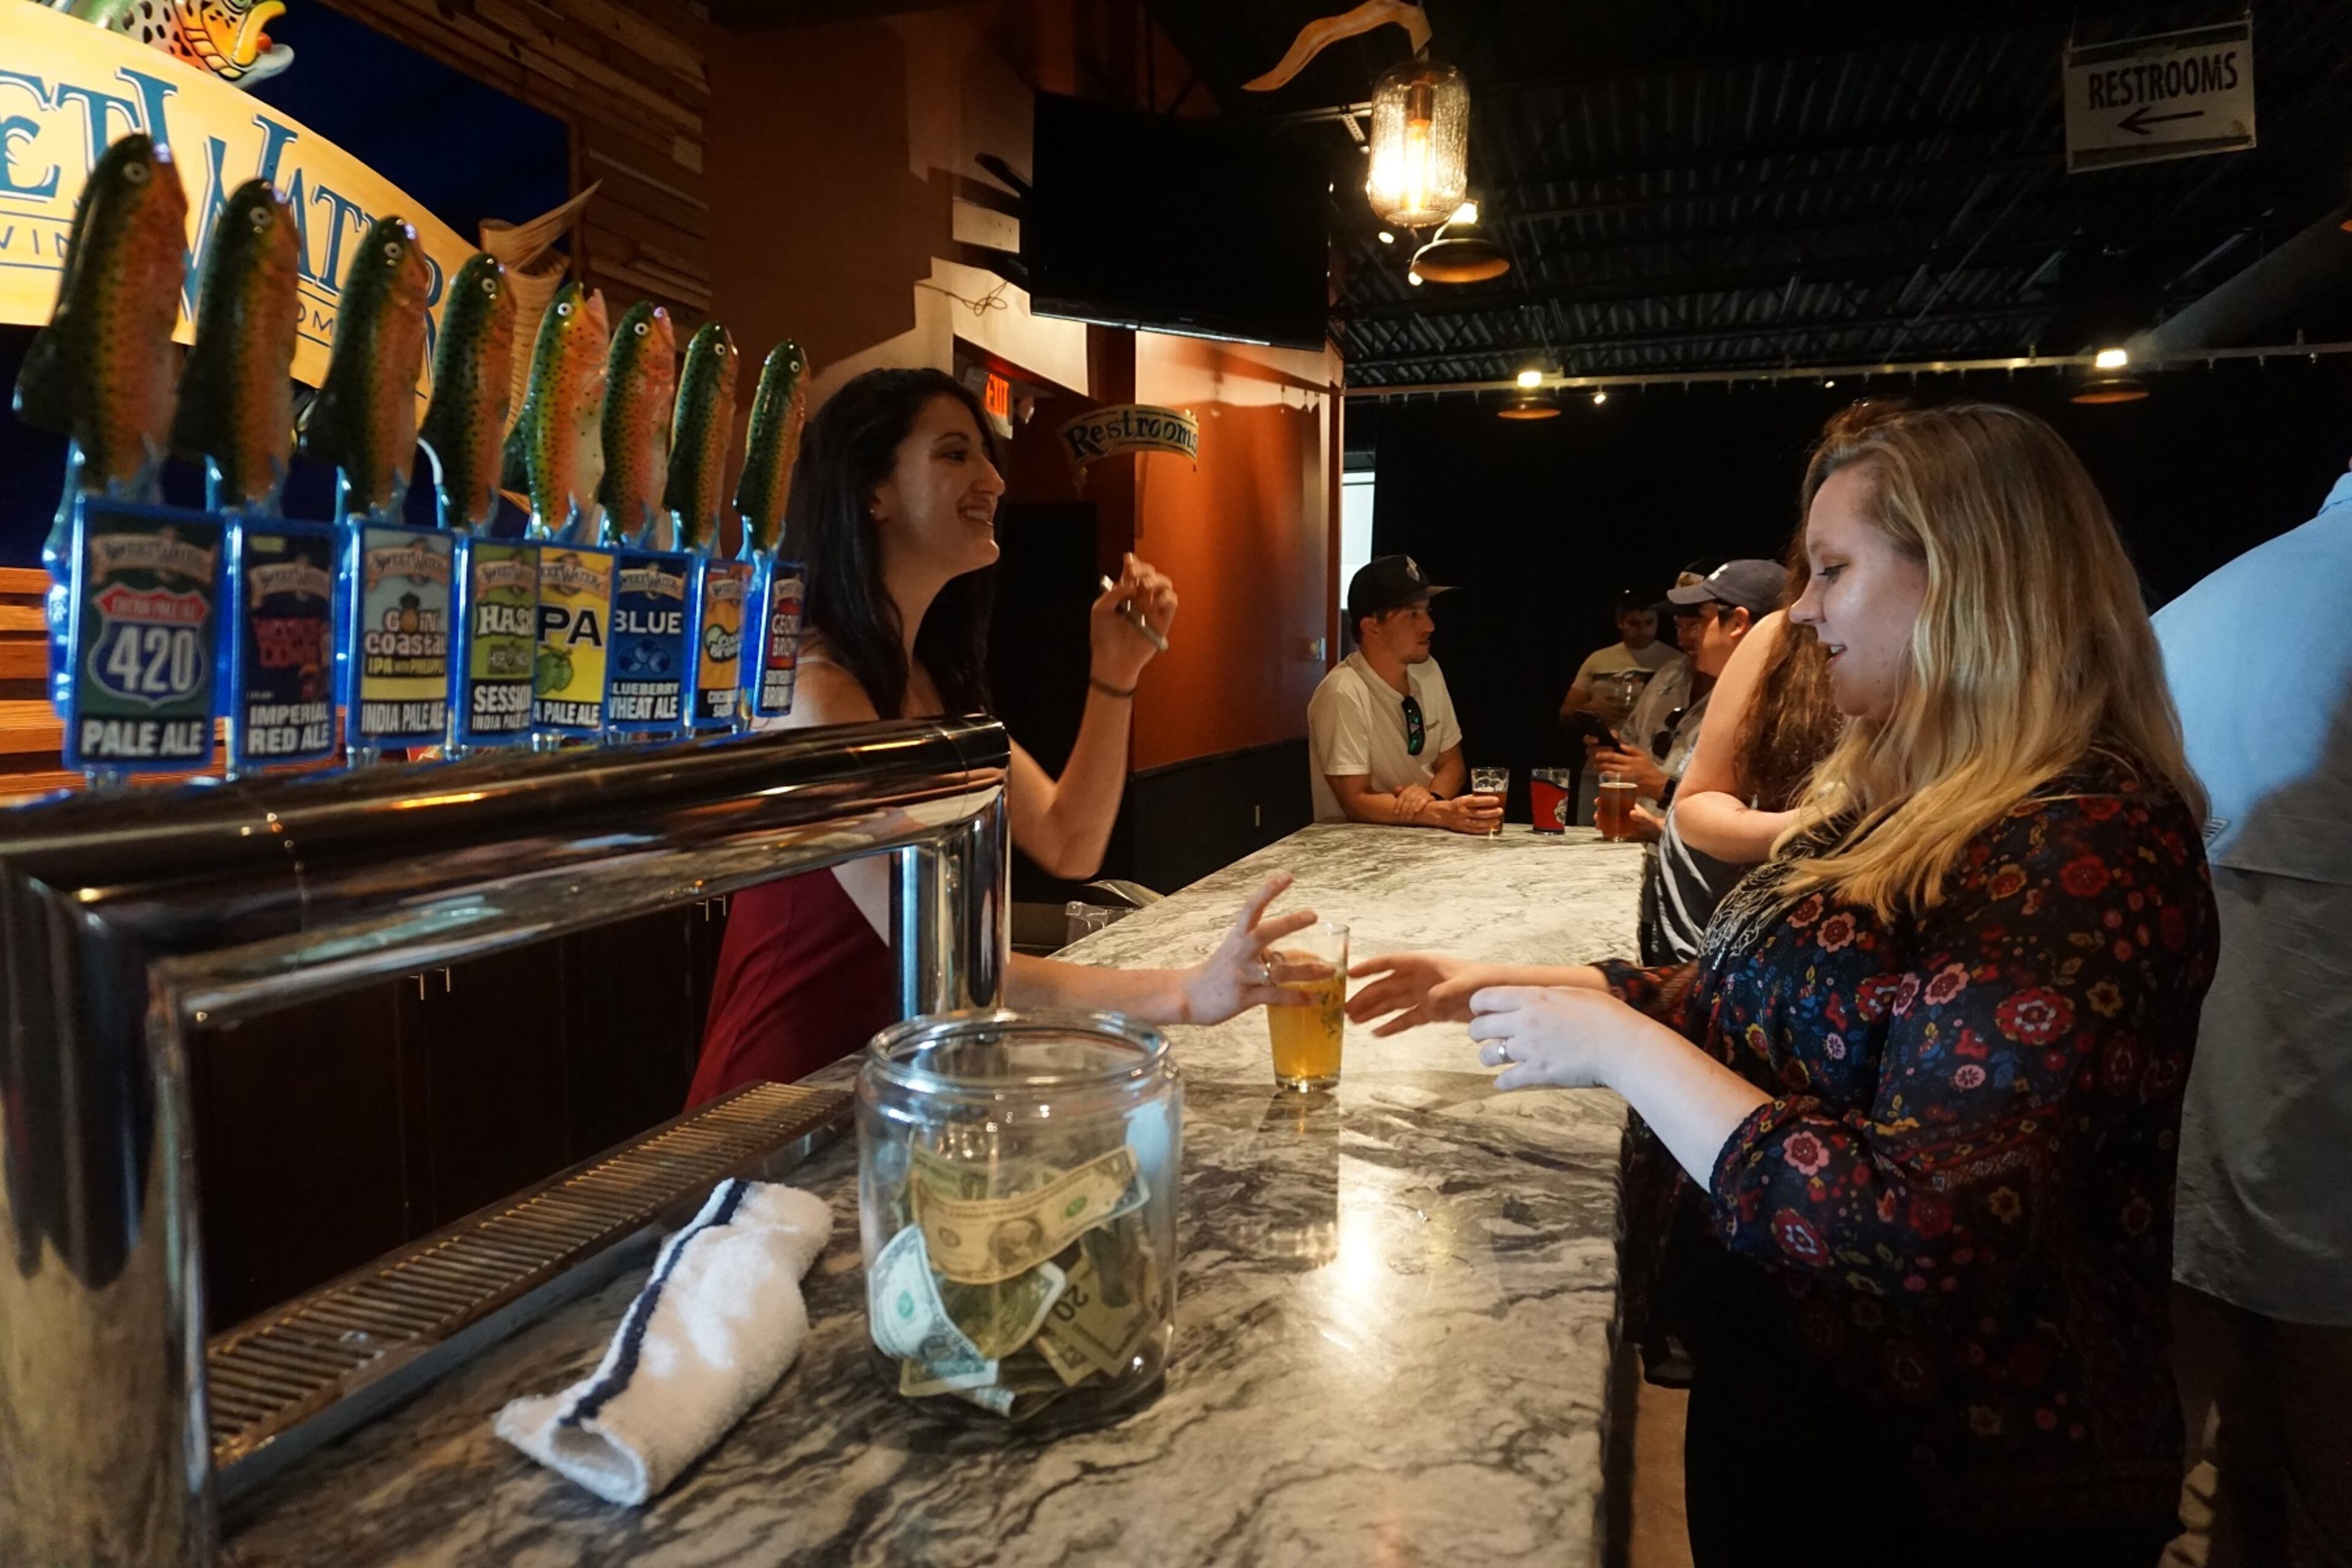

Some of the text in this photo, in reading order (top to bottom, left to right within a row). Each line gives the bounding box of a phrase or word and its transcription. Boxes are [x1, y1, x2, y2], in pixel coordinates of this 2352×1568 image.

[2088, 51, 2238, 110] RESTROOMS
[1066, 409, 1198, 458] Restrooms
[613, 609, 682, 634] BLUE
[107, 624, 195, 692] 420
[368, 656, 394, 674] IPA
[609, 682, 679, 695] LUEBERRY
[249, 702, 330, 726] IMPERIAL
[361, 703, 399, 734] INDIA
[402, 703, 429, 732] PALE
[543, 701, 576, 725] PALE
[576, 704, 600, 726] ALE
[654, 696, 679, 720] ALE
[472, 714, 501, 731] INDIA
[81, 719, 203, 756] PALE ALE
[248, 722, 329, 755] RED ALE
